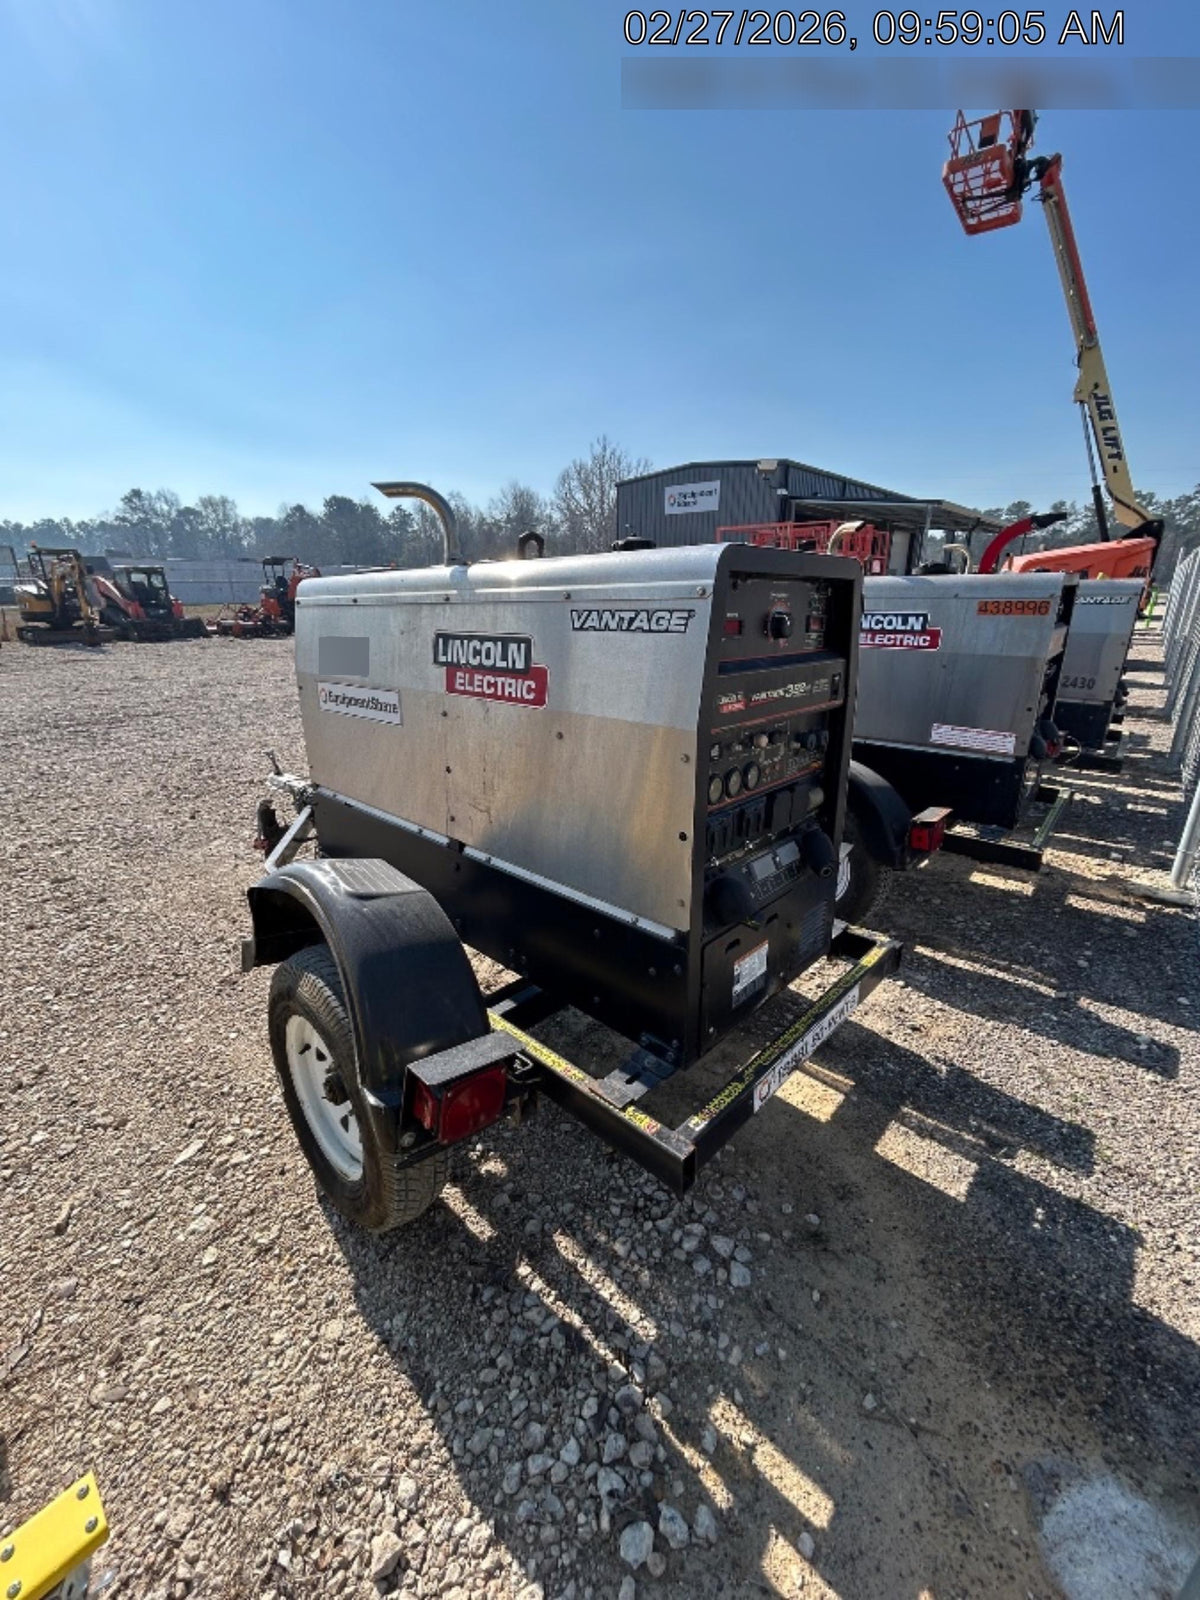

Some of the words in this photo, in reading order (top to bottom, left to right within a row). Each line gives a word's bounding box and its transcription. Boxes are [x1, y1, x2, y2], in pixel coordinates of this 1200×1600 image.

[978, 601, 1051, 615] 438996
[571, 609, 691, 633] VANTAGE
[860, 614, 923, 630] NCOLN
[438, 637, 526, 670] LINCOLN
[455, 671, 536, 700] ELECTRIC
[1061, 677, 1096, 690] 2430
